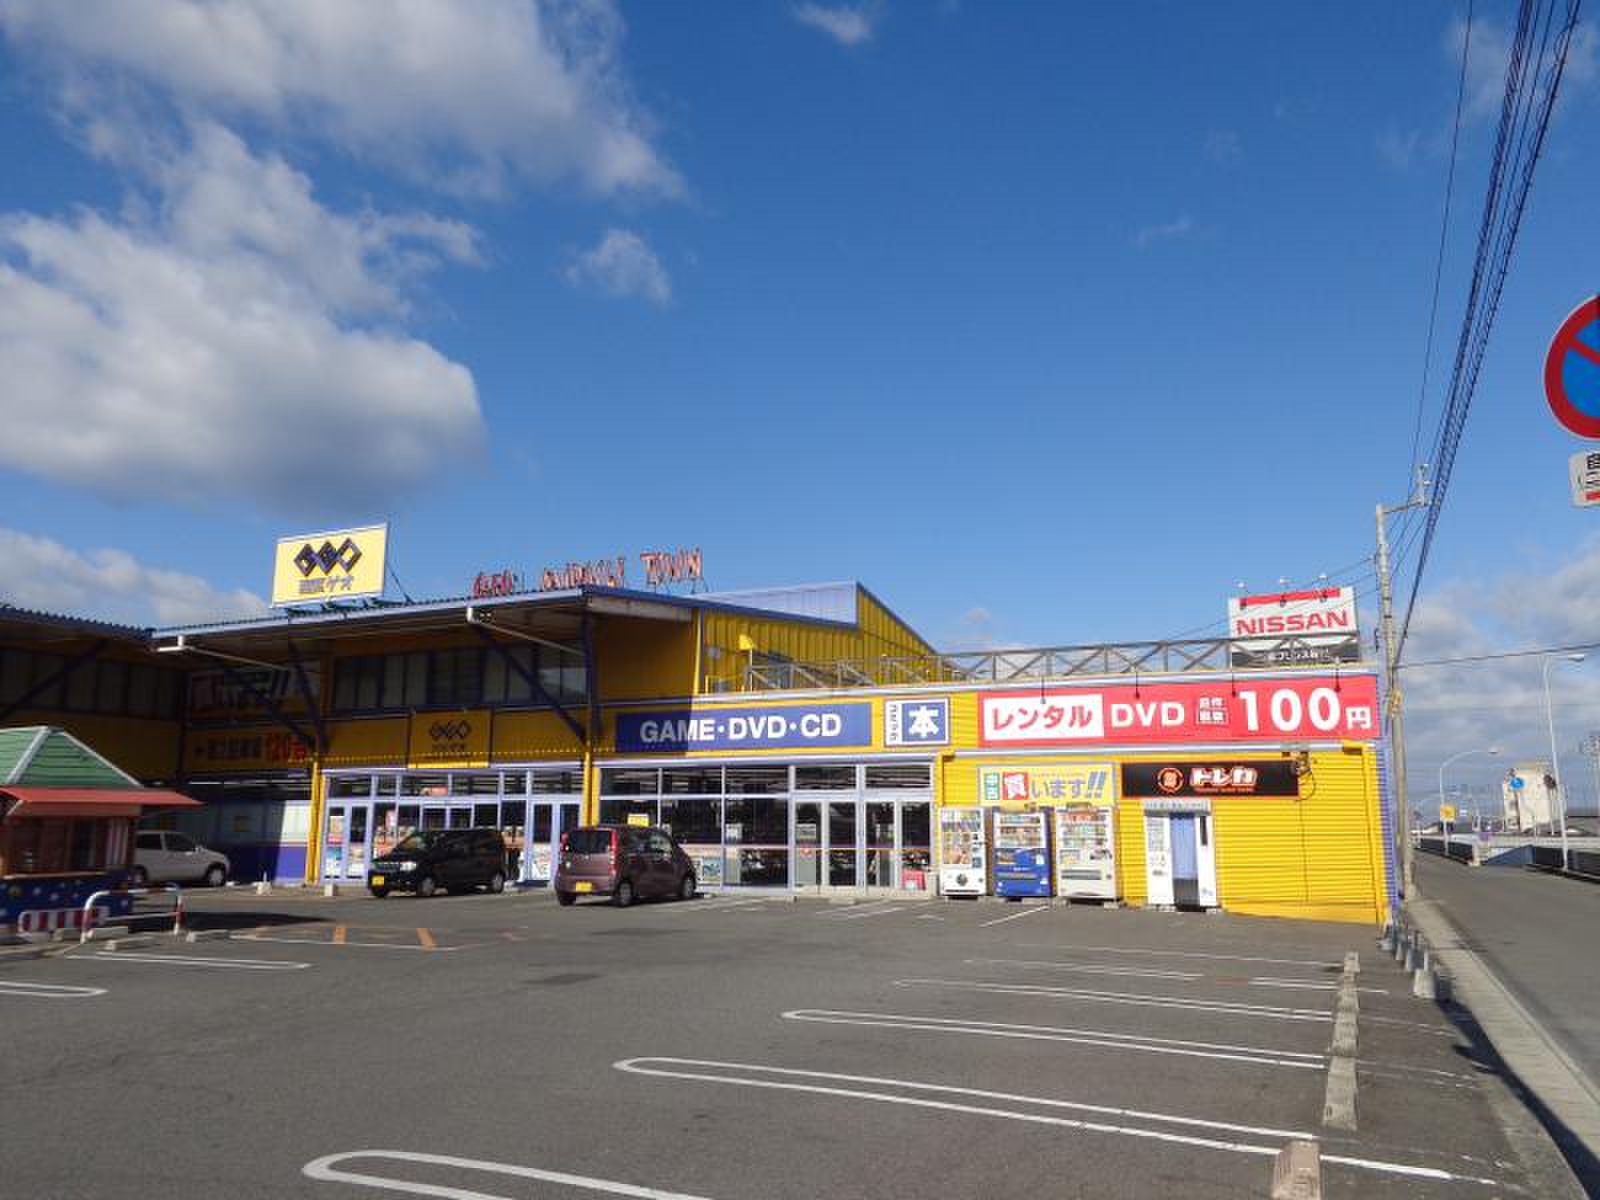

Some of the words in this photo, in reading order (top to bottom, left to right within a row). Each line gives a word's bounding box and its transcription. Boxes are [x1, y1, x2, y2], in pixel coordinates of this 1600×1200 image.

[1236, 610, 1348, 634] NISSAN
[908, 705, 939, 738] 本
[992, 704, 1093, 731] レンタル
[1110, 702, 1185, 727] DVD
[1191, 766, 1257, 787] トレカ
